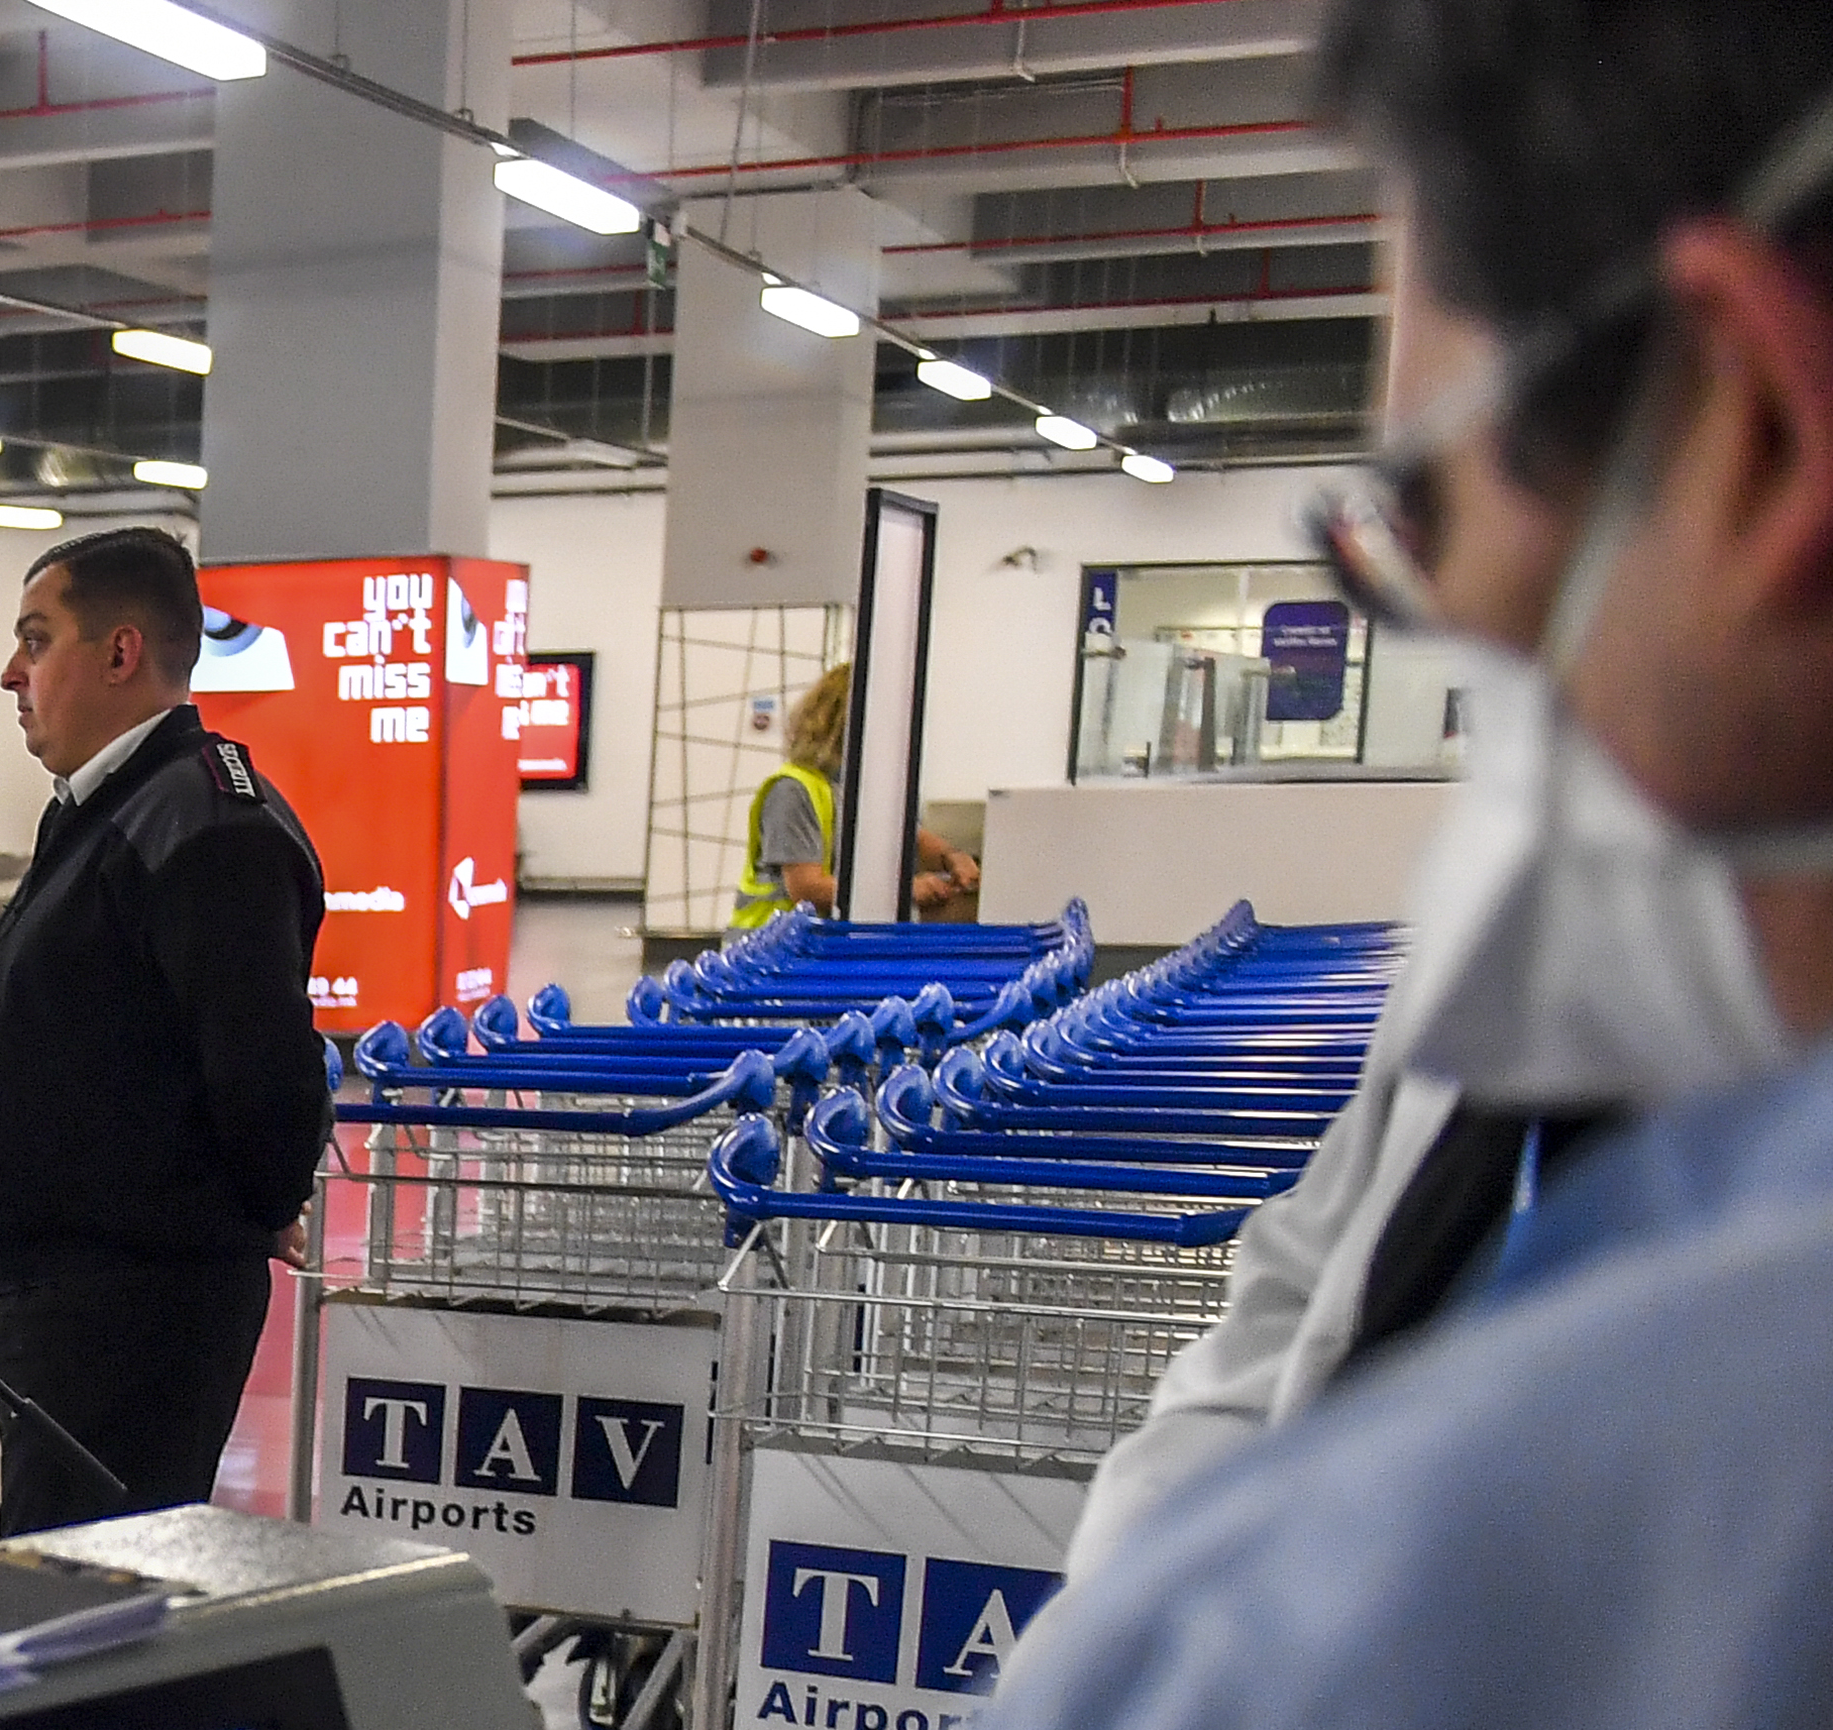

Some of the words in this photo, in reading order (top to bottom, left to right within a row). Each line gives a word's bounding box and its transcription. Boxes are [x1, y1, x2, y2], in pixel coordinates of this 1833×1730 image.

[363, 574, 432, 622] you
[322, 610, 431, 658] can't
[338, 655, 431, 701] miss
[370, 706, 430, 743] me
[216, 743, 257, 798] SECURITY
[363, 1396, 665, 1491] TAV
[339, 1484, 537, 1537] Airports
[791, 1566, 1021, 1679] TA
